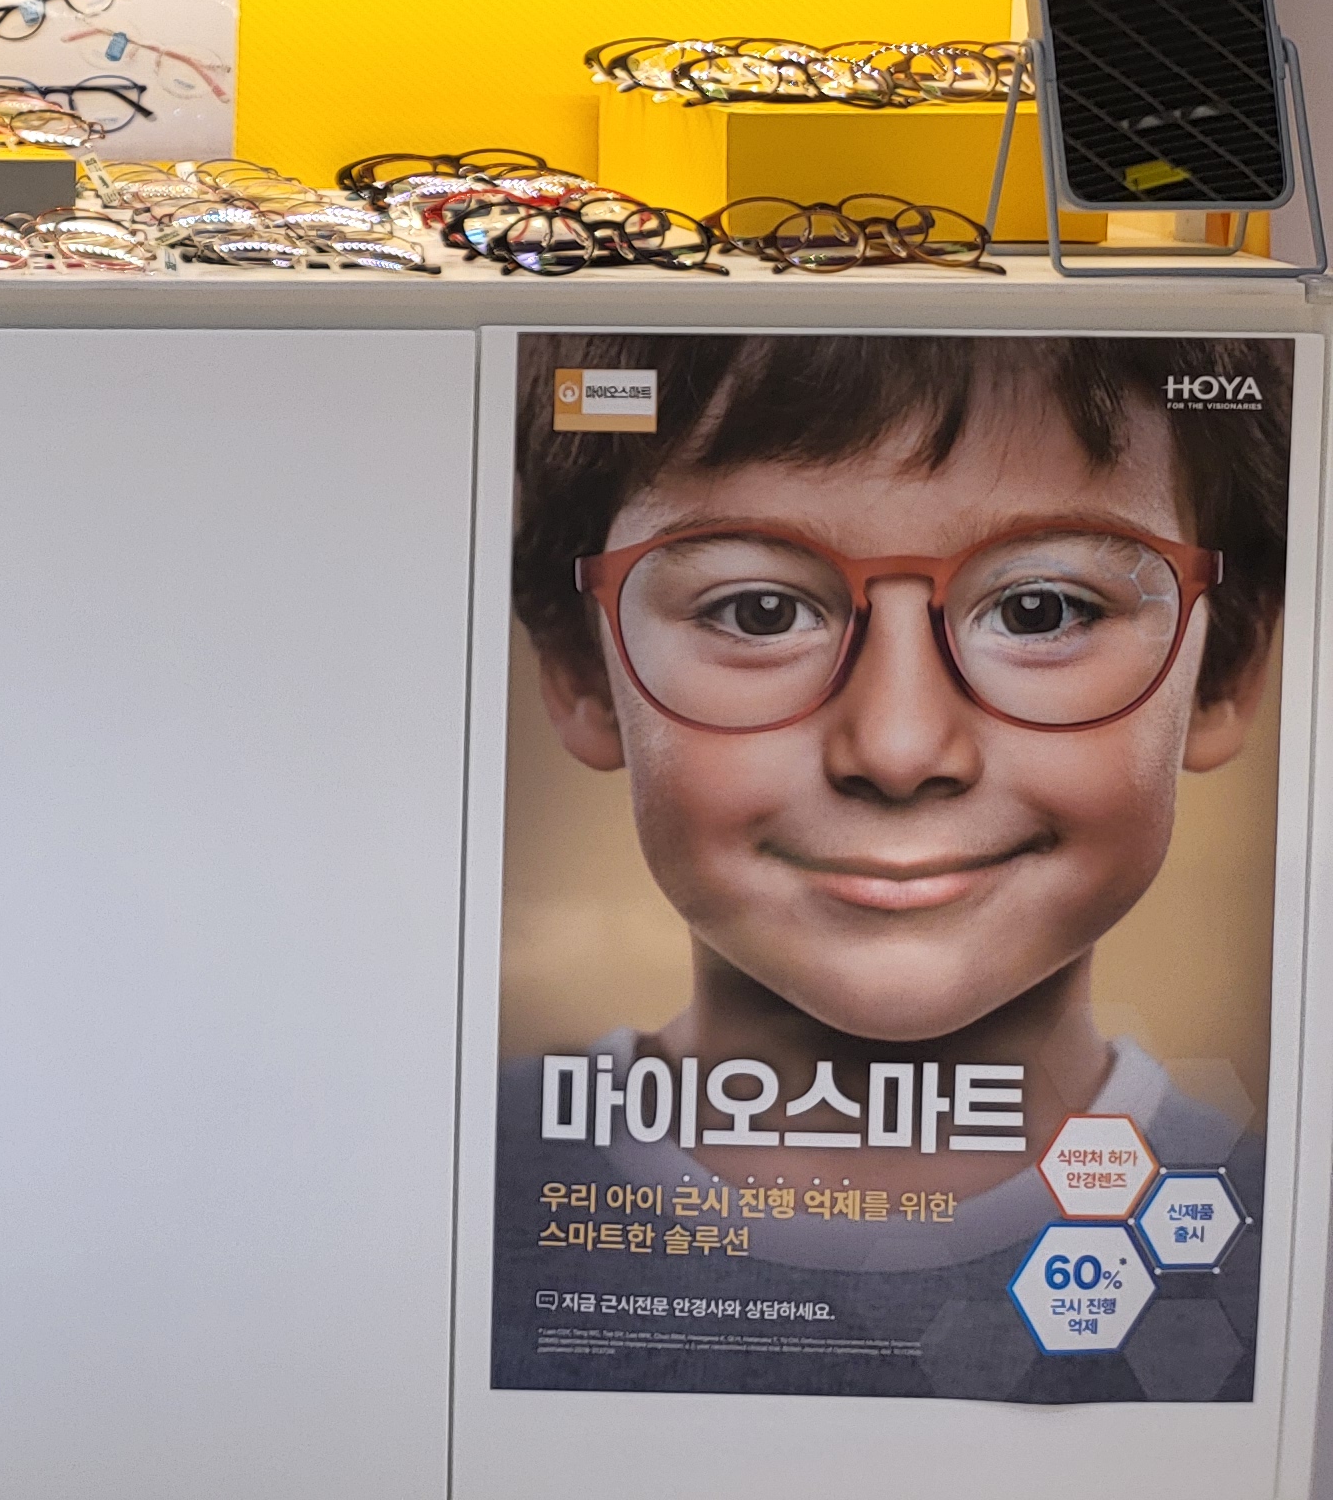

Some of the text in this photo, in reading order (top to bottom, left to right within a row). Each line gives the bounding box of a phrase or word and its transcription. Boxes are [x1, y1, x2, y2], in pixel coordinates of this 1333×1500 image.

[585, 385, 652, 399] 마이오스마트
[1161, 376, 1263, 400] HOYA
[1167, 402, 1262, 410] FOR THE VISIONARIES
[541, 1054, 1027, 1154] 마이오스마트
[1057, 1150, 1138, 1167] 식약처 허가
[1066, 1172, 1127, 1189] 안경렌즈
[540, 1182, 957, 1224] 우리 아이 근시 진행 억제를 위한
[1167, 1204, 1214, 1221] 신제품
[539, 1221, 750, 1257] 스마트한 솔루션
[1174, 1226, 1205, 1243] 출시
[562, 1294, 835, 1321] 지금 근시전문 안경사와 상담하세요.
[1050, 1298, 1117, 1315] 근시 진행
[1068, 1318, 1098, 1335] 억제
